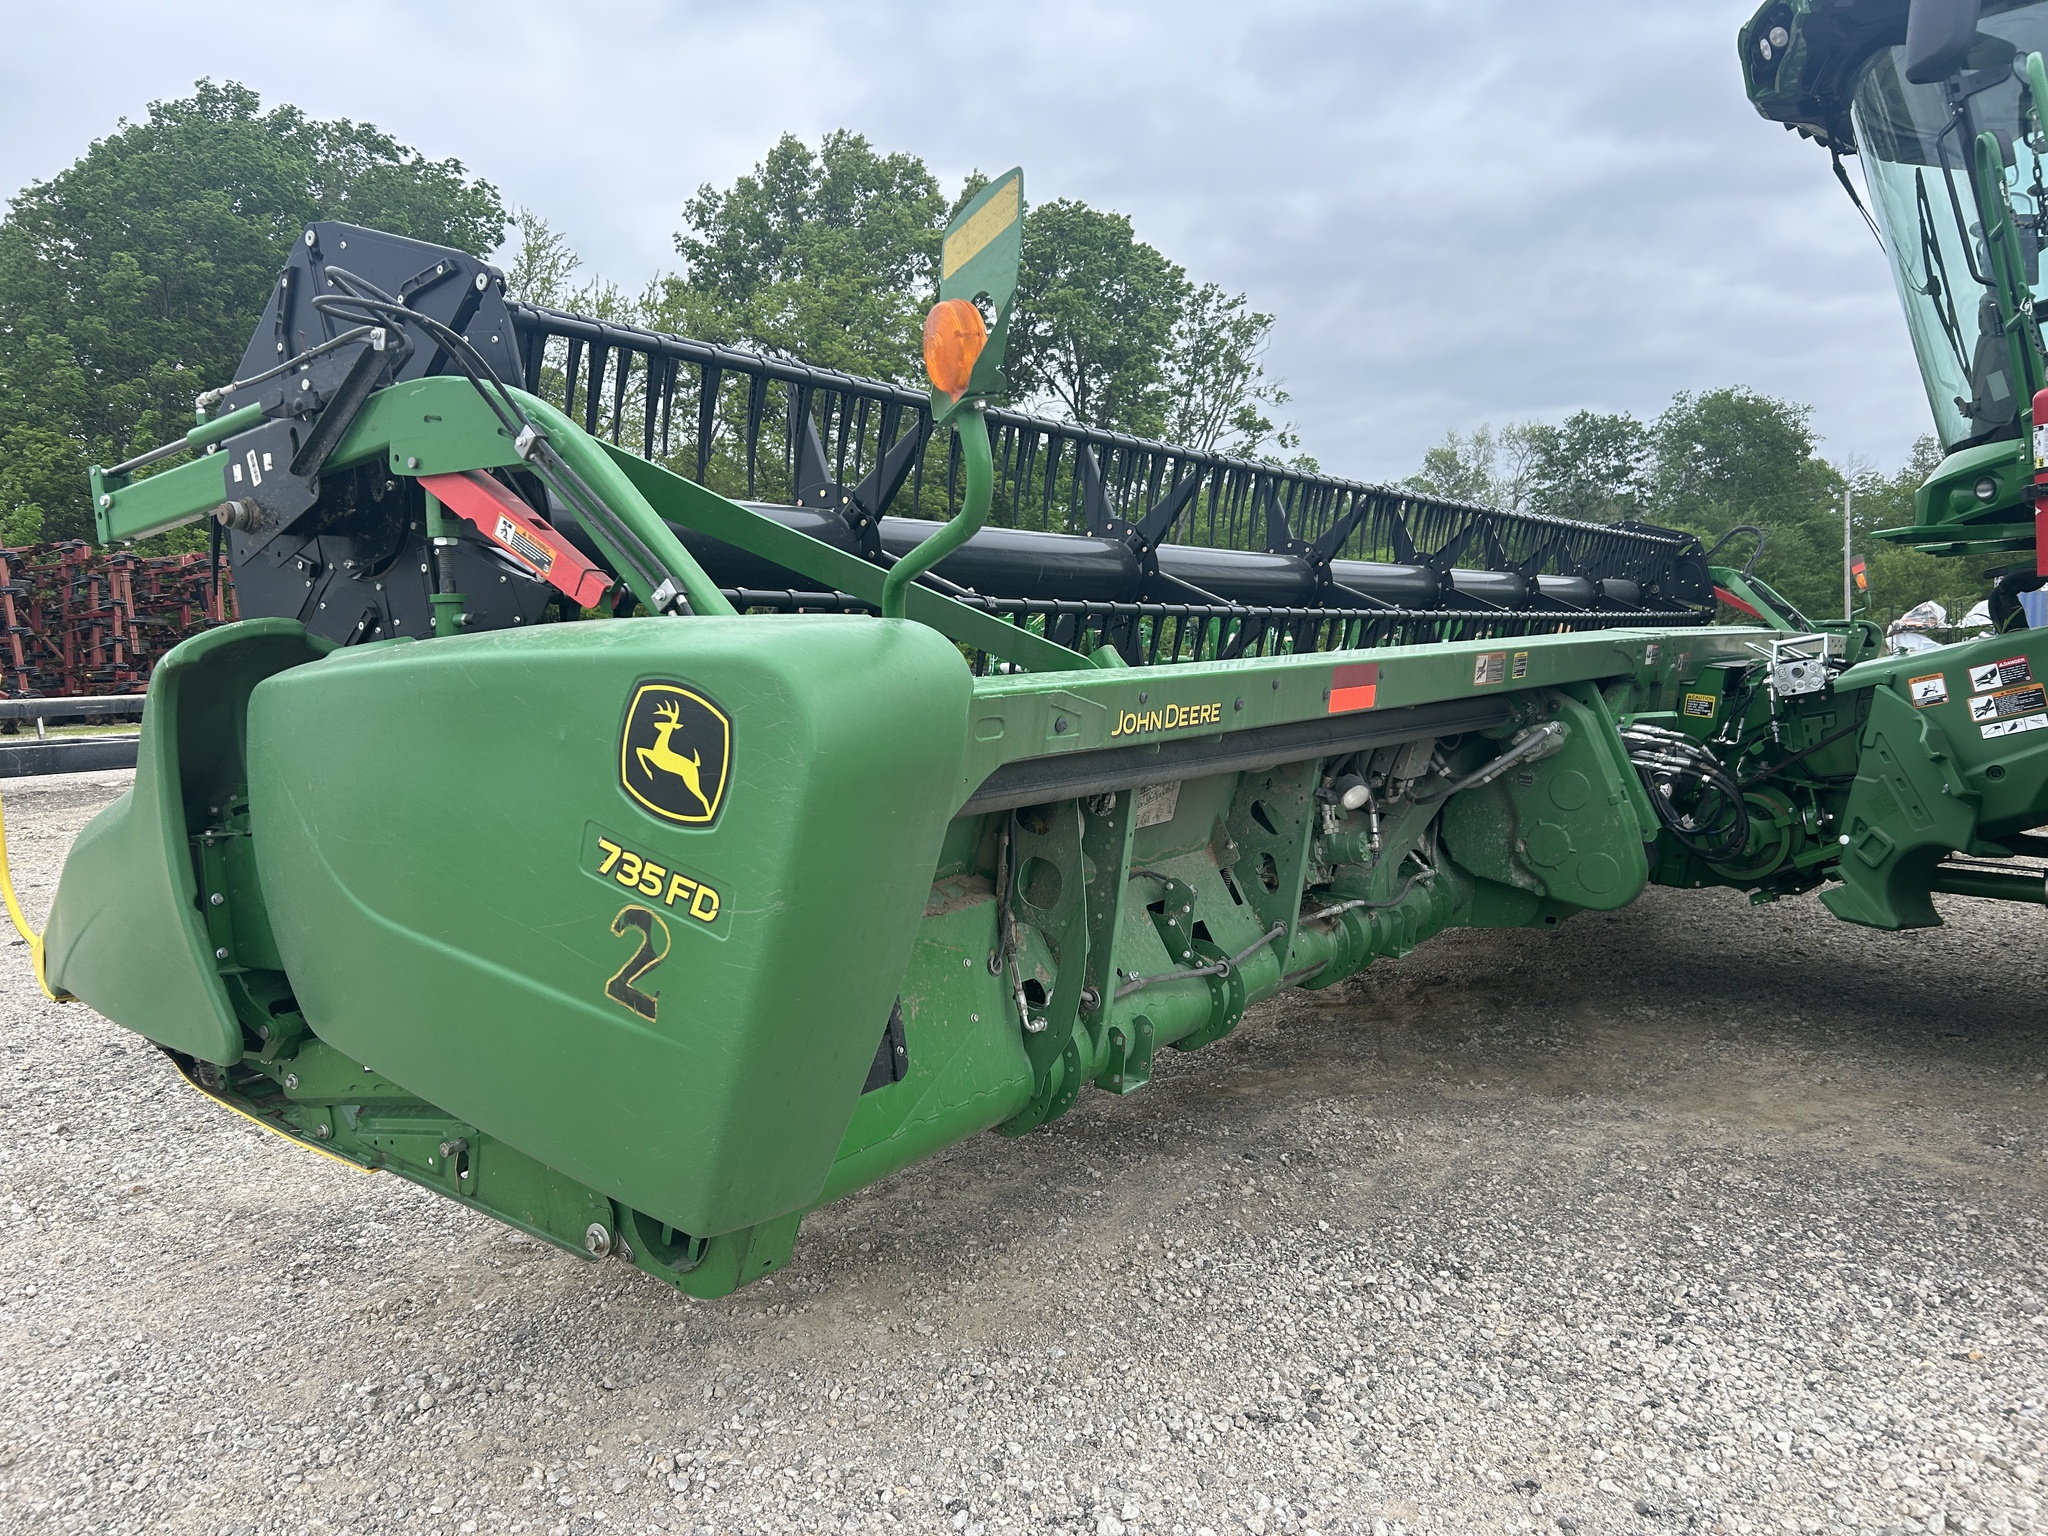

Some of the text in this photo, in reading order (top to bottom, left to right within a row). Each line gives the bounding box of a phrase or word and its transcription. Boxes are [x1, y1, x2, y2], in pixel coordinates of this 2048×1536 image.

[1691, 694, 1714, 702] CAUTION
[1110, 702, 1222, 738] JOHN DEERE
[604, 903, 672, 1023] 2
